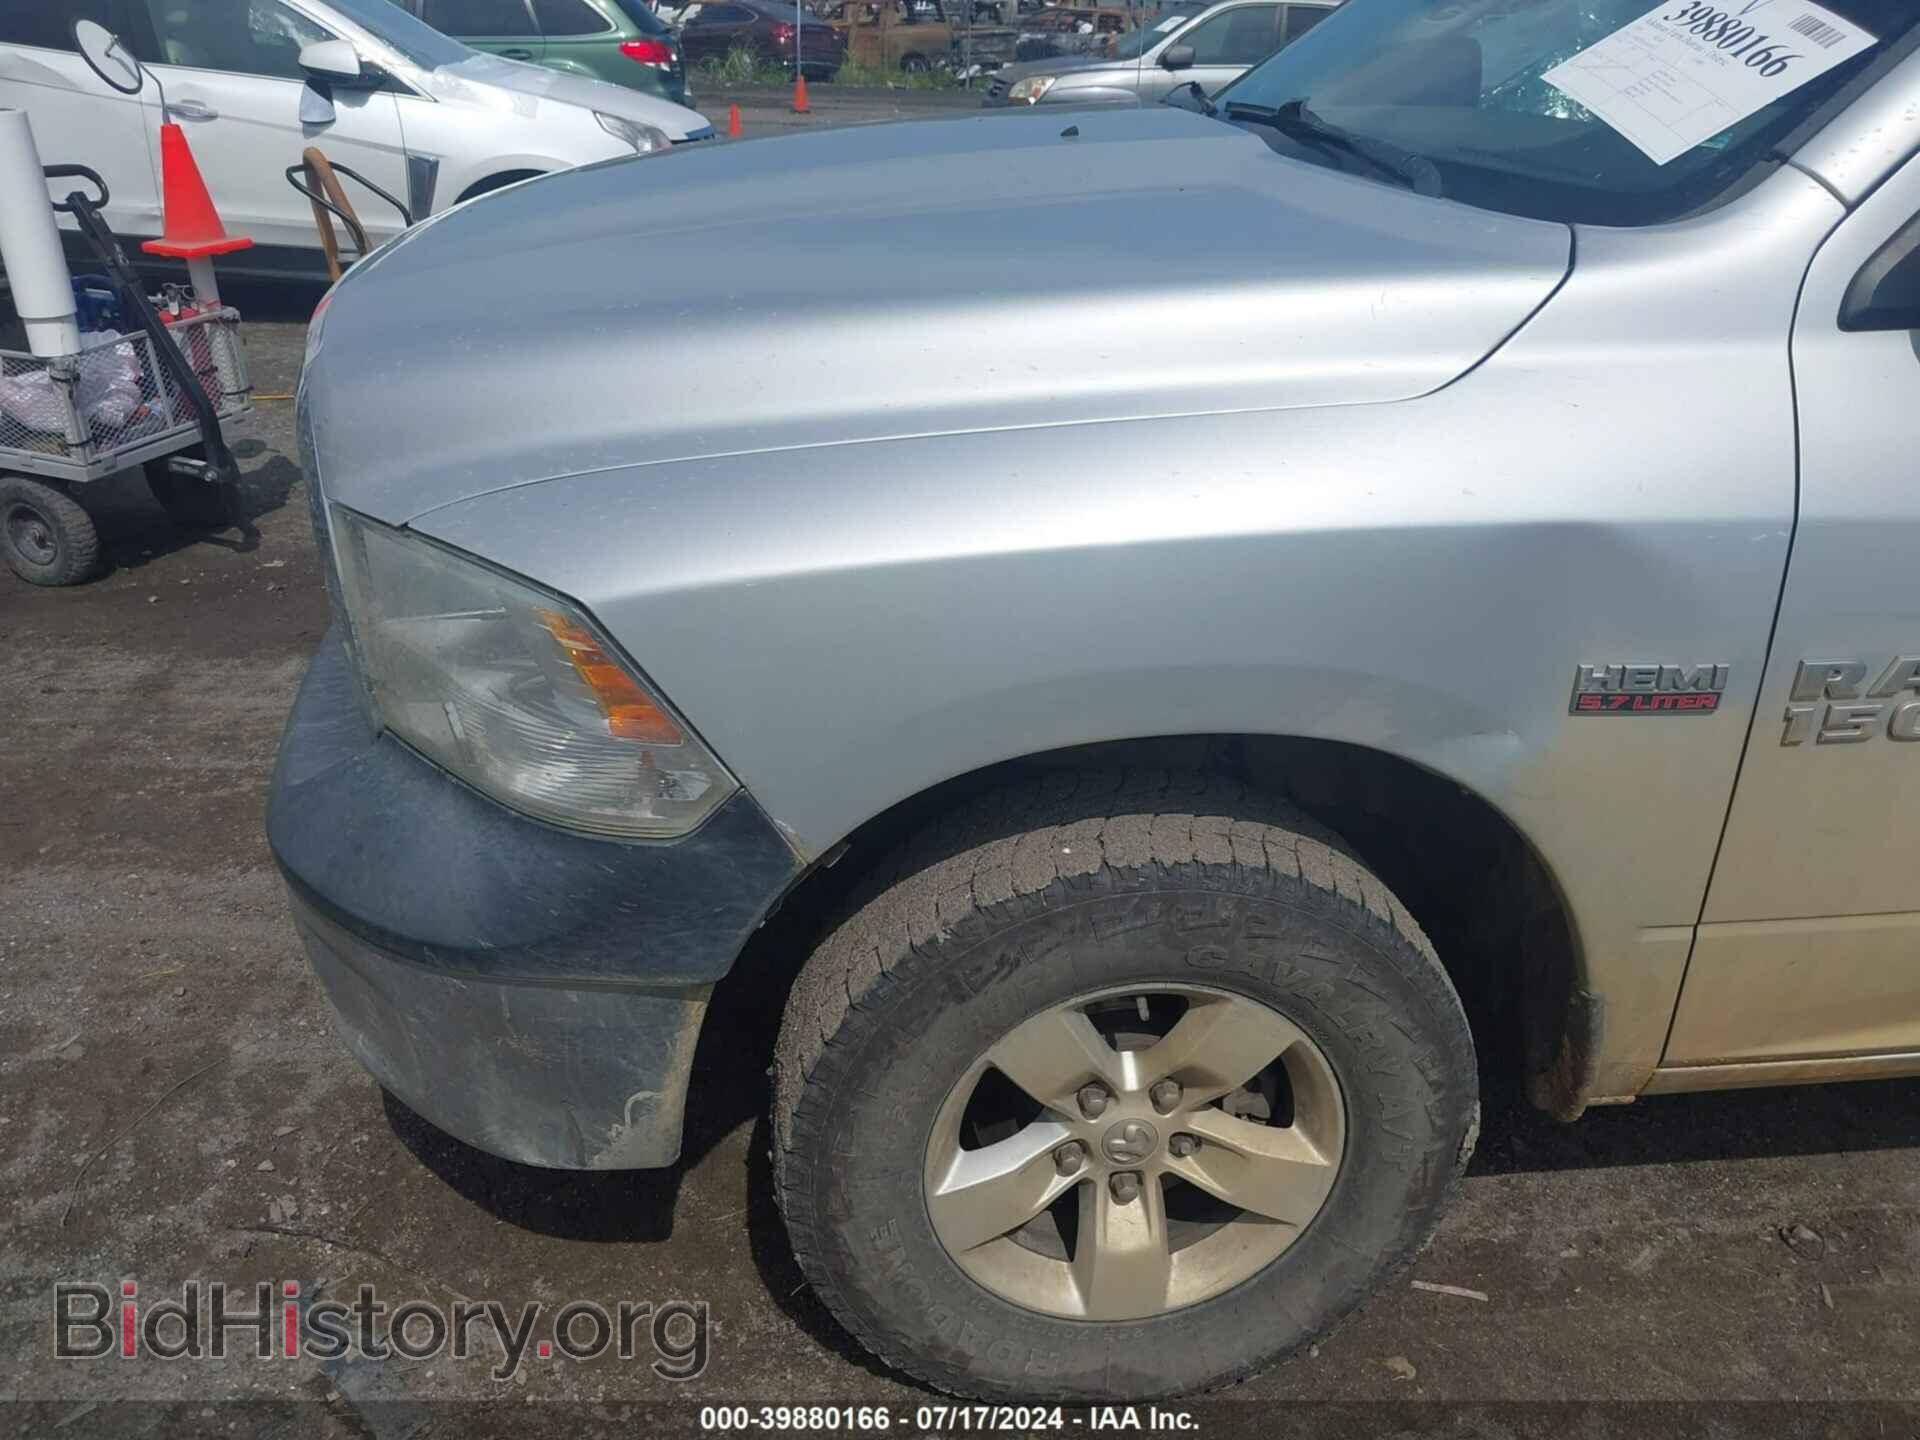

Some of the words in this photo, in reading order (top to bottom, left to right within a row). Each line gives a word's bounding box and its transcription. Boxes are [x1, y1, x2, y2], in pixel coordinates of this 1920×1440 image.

[1663, 0, 1805, 78] 39880166
[1576, 663, 1730, 692] HEMI
[1578, 694, 1631, 711] 5.7
[1632, 693, 1719, 710] LITER
